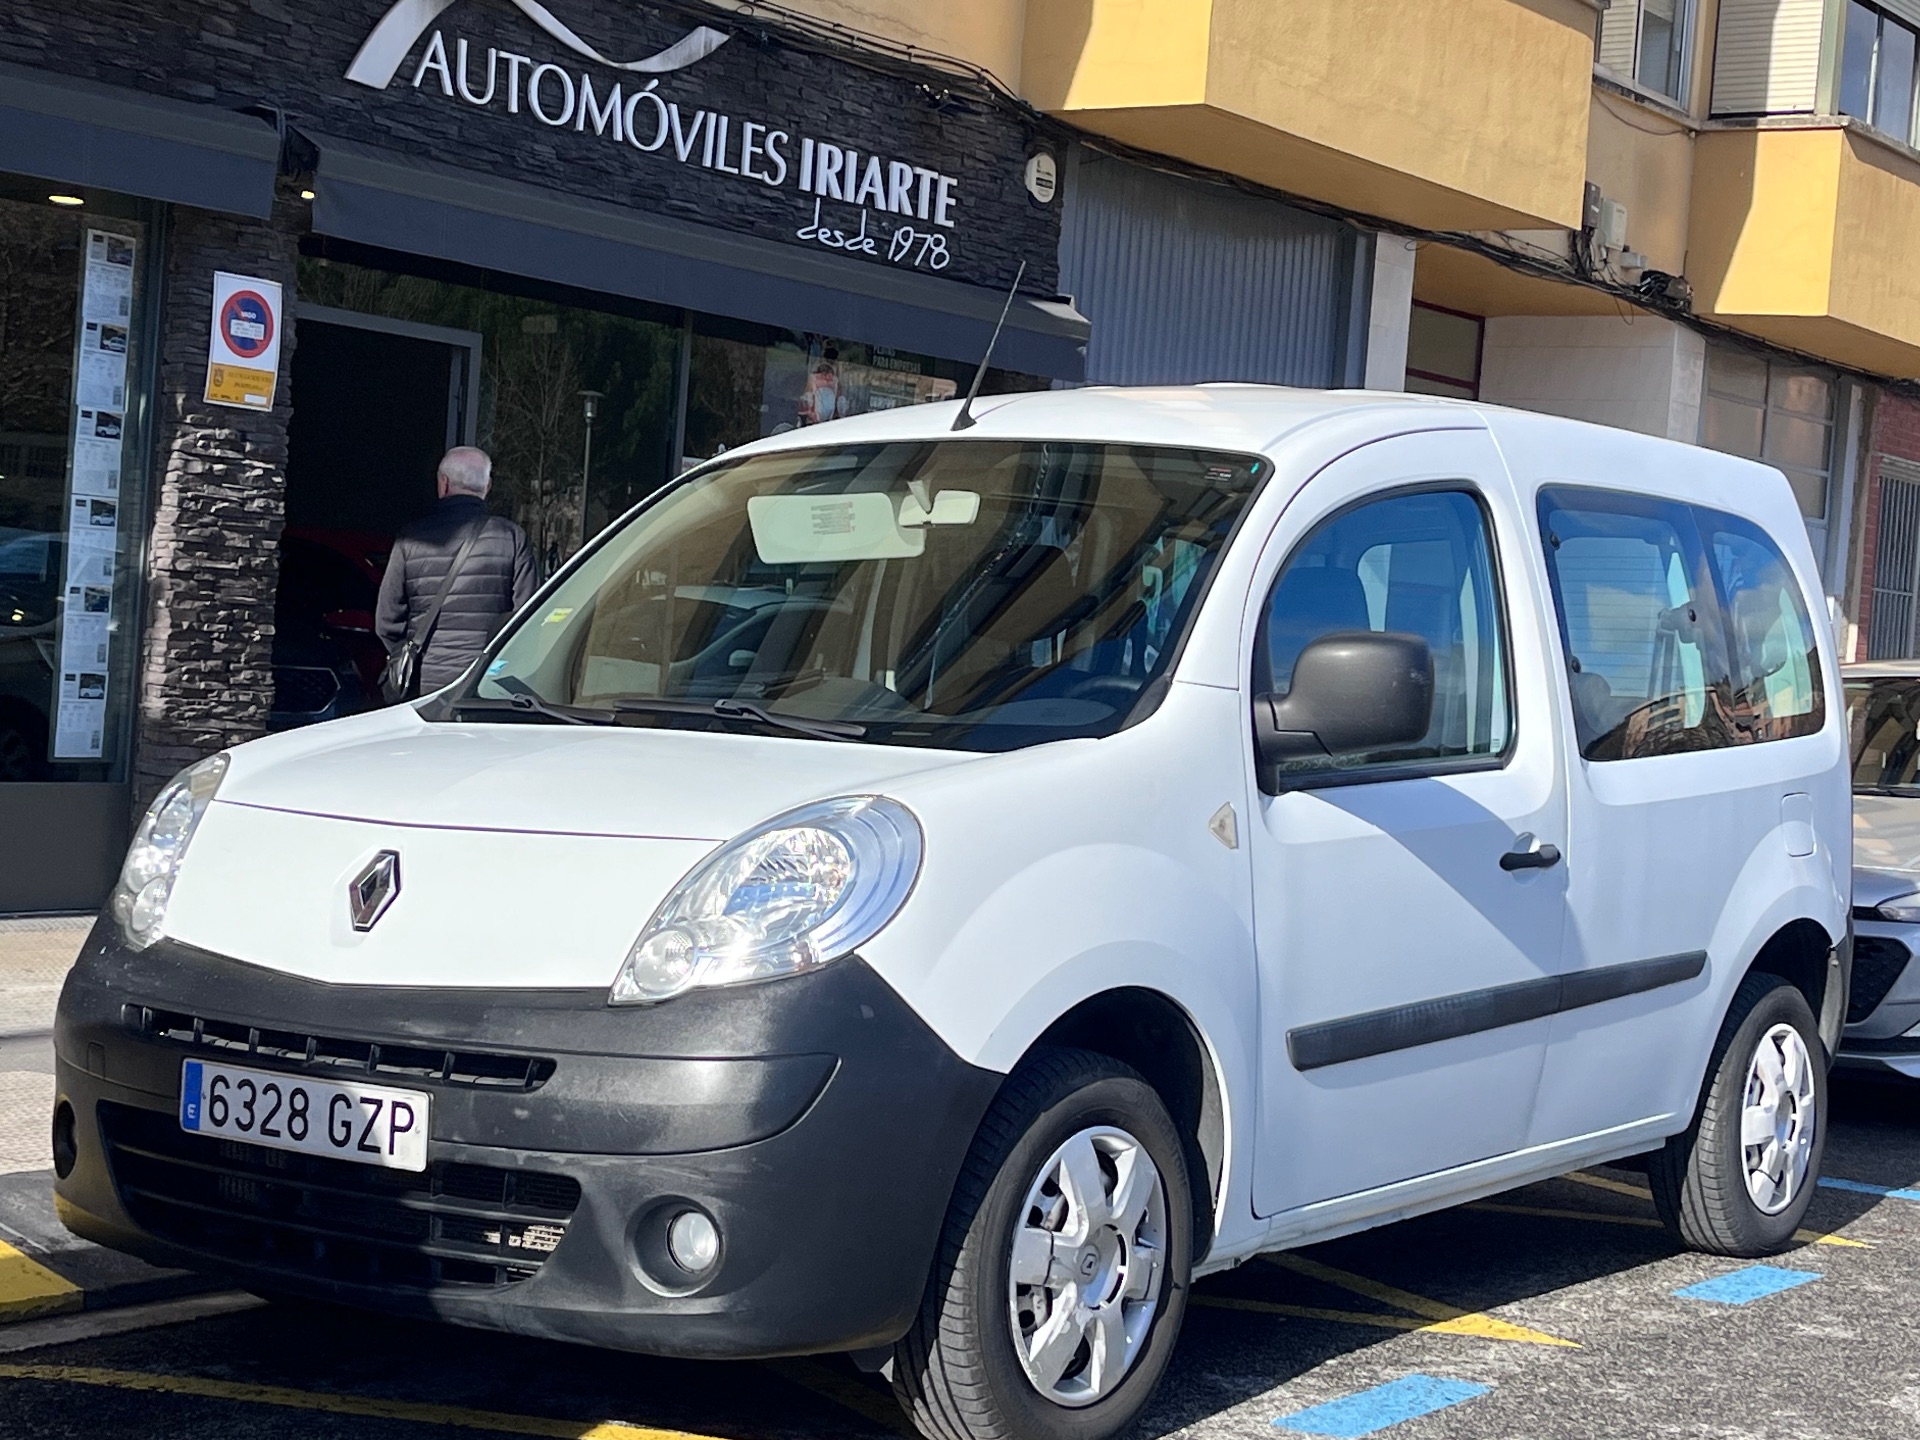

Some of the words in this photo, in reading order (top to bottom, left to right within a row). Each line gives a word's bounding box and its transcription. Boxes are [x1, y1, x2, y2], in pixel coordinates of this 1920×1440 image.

[411, 29, 789, 186] AUTOMÓVILES
[798, 137, 958, 228] IRIARTE
[796, 197, 877, 255] desde
[887, 226, 950, 269] 1978
[208, 1074, 310, 1141] 6328
[327, 1093, 415, 1156] GZP
